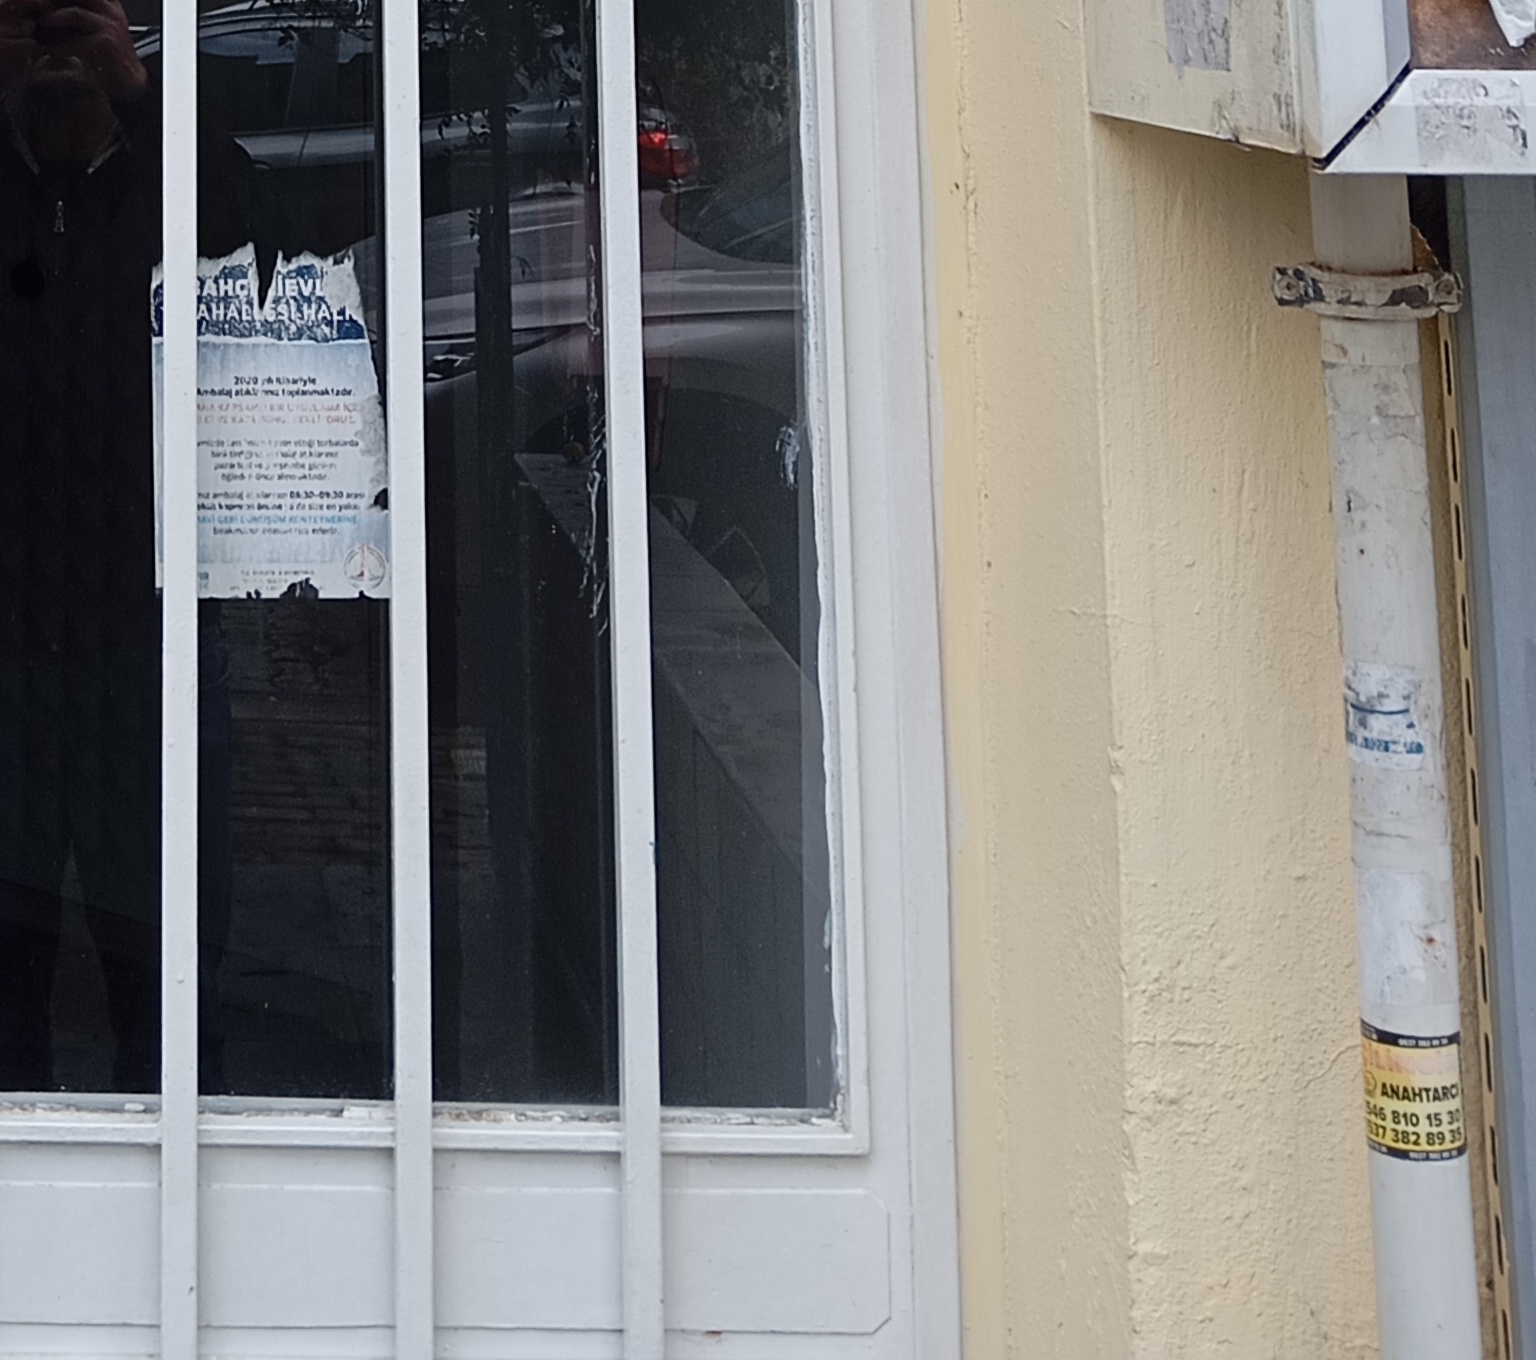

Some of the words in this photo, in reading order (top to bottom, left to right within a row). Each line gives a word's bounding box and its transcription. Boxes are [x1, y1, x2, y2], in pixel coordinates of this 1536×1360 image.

[1390, 1110, 1420, 1127] 810
[1425, 1112, 1443, 1128] 15
[1446, 1108, 1462, 1125] 30
[1390, 1128, 1422, 1147] 382
[1426, 1131, 1446, 1146] 89
